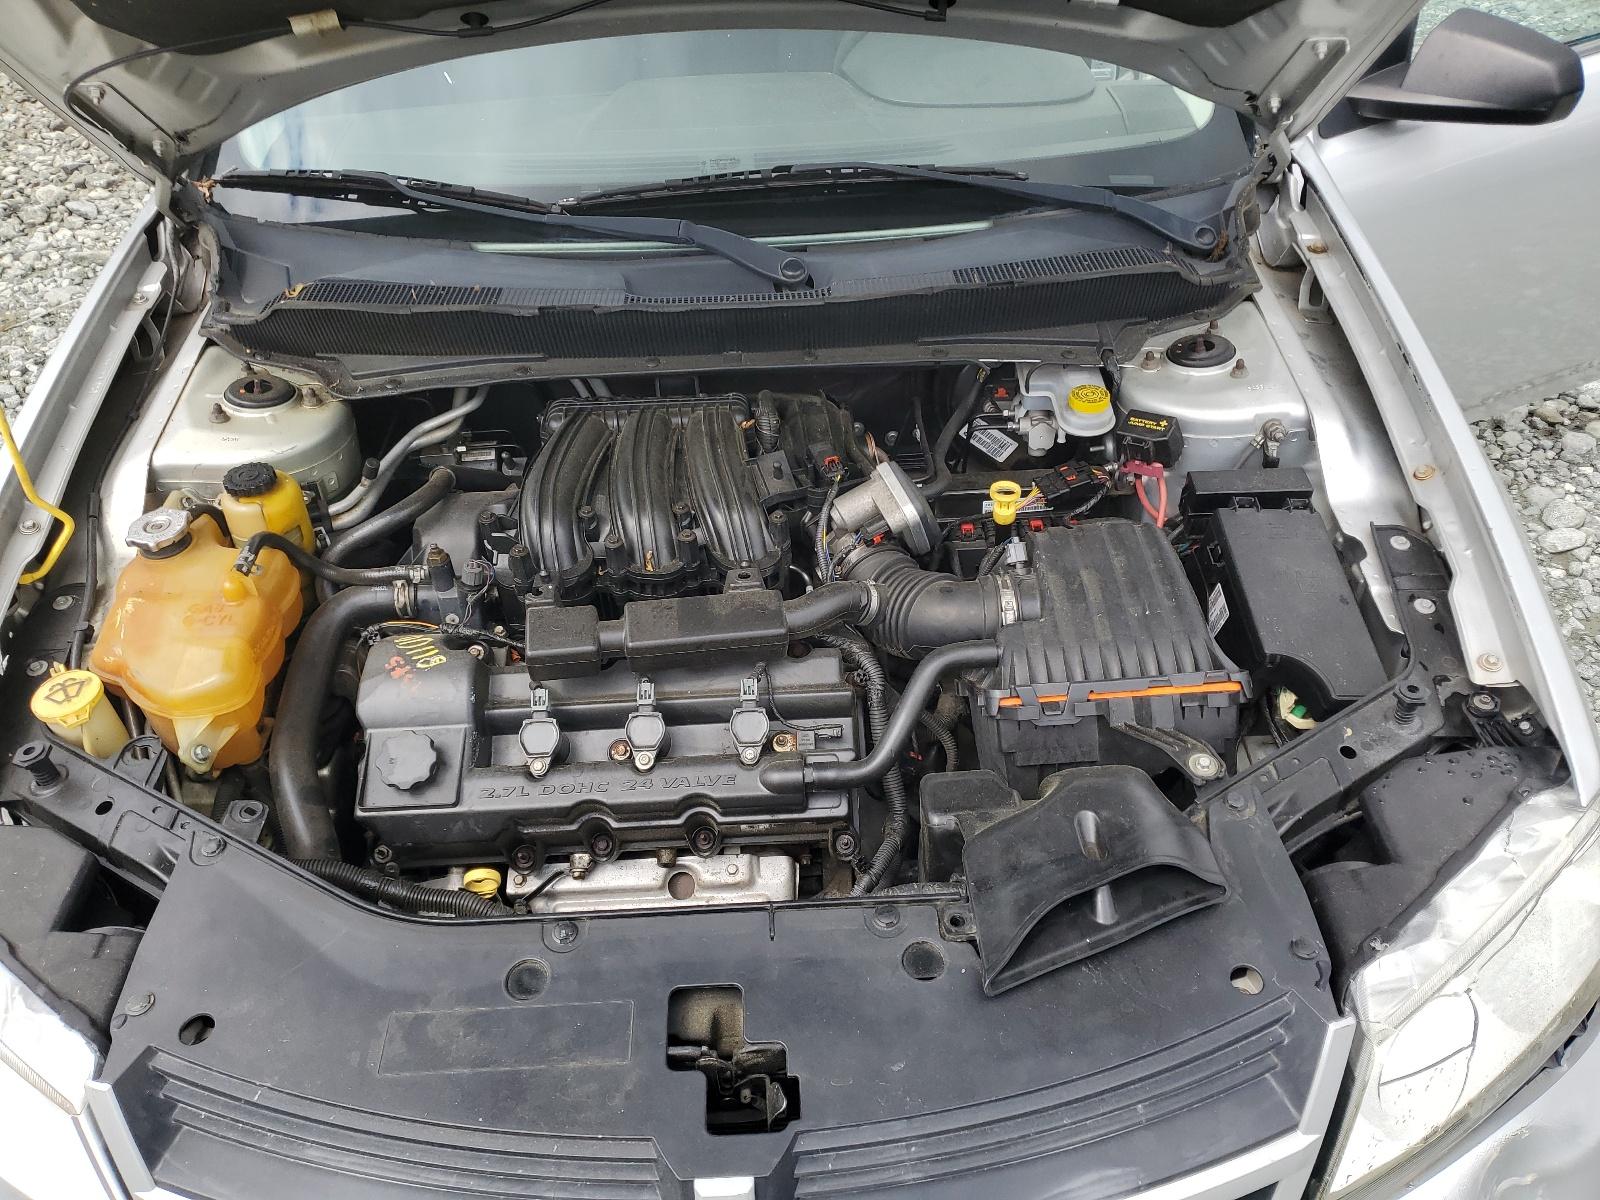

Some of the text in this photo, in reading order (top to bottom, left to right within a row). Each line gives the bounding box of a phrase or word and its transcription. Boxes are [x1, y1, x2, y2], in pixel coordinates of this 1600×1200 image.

[1129, 416, 1158, 426] BATTERY
[480, 773, 737, 800] 2.7L DOHC 24 VALVE
